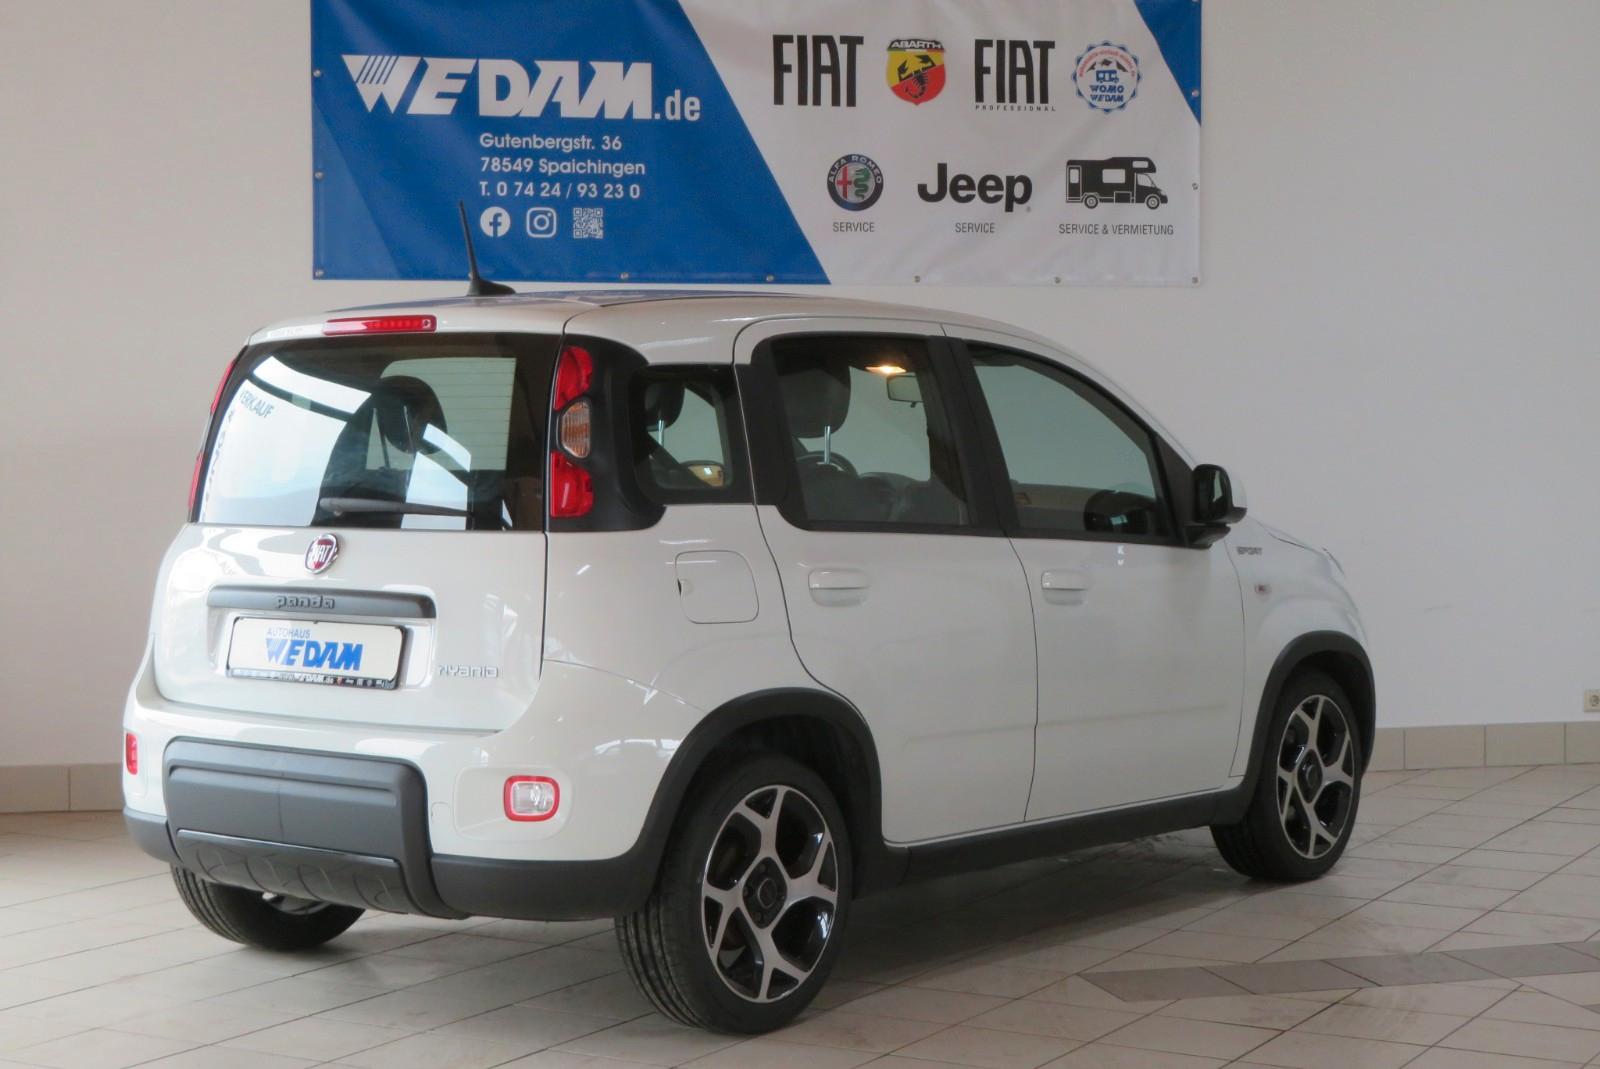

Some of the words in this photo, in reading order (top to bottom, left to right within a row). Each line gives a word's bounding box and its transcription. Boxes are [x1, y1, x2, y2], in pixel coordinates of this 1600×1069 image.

[891, 40, 941, 49] ABARTH
[773, 34, 864, 108] FIAT
[975, 39, 1055, 104] FIAT
[1089, 85, 1124, 93] WOMO
[479, 133, 595, 153] Gutenbergstr.
[601, 135, 622, 150] 36
[480, 157, 534, 173] 78549
[539, 158, 646, 178] Spaichingen
[828, 158, 847, 183] ALFA
[851, 155, 882, 184] ROMEO
[479, 181, 490, 196] T.
[496, 181, 508, 197] 0
[514, 181, 535, 197] 74
[539, 182, 561, 197] 24
[576, 183, 598, 198] 93
[603, 183, 624, 198] 23
[629, 184, 641, 199] 0
[917, 163, 1032, 212] Jeep
[832, 222, 875, 232] SERVICE
[955, 222, 995, 233] SERVICE
[1058, 223, 1099, 234] SERVICE
[1102, 224, 1109, 234] &
[1111, 224, 1174, 235] VERMIETUNG
[274, 595, 335, 609] panda
[266, 627, 310, 639] AUTOHAUS
[266, 638, 363, 671] WEDAM
